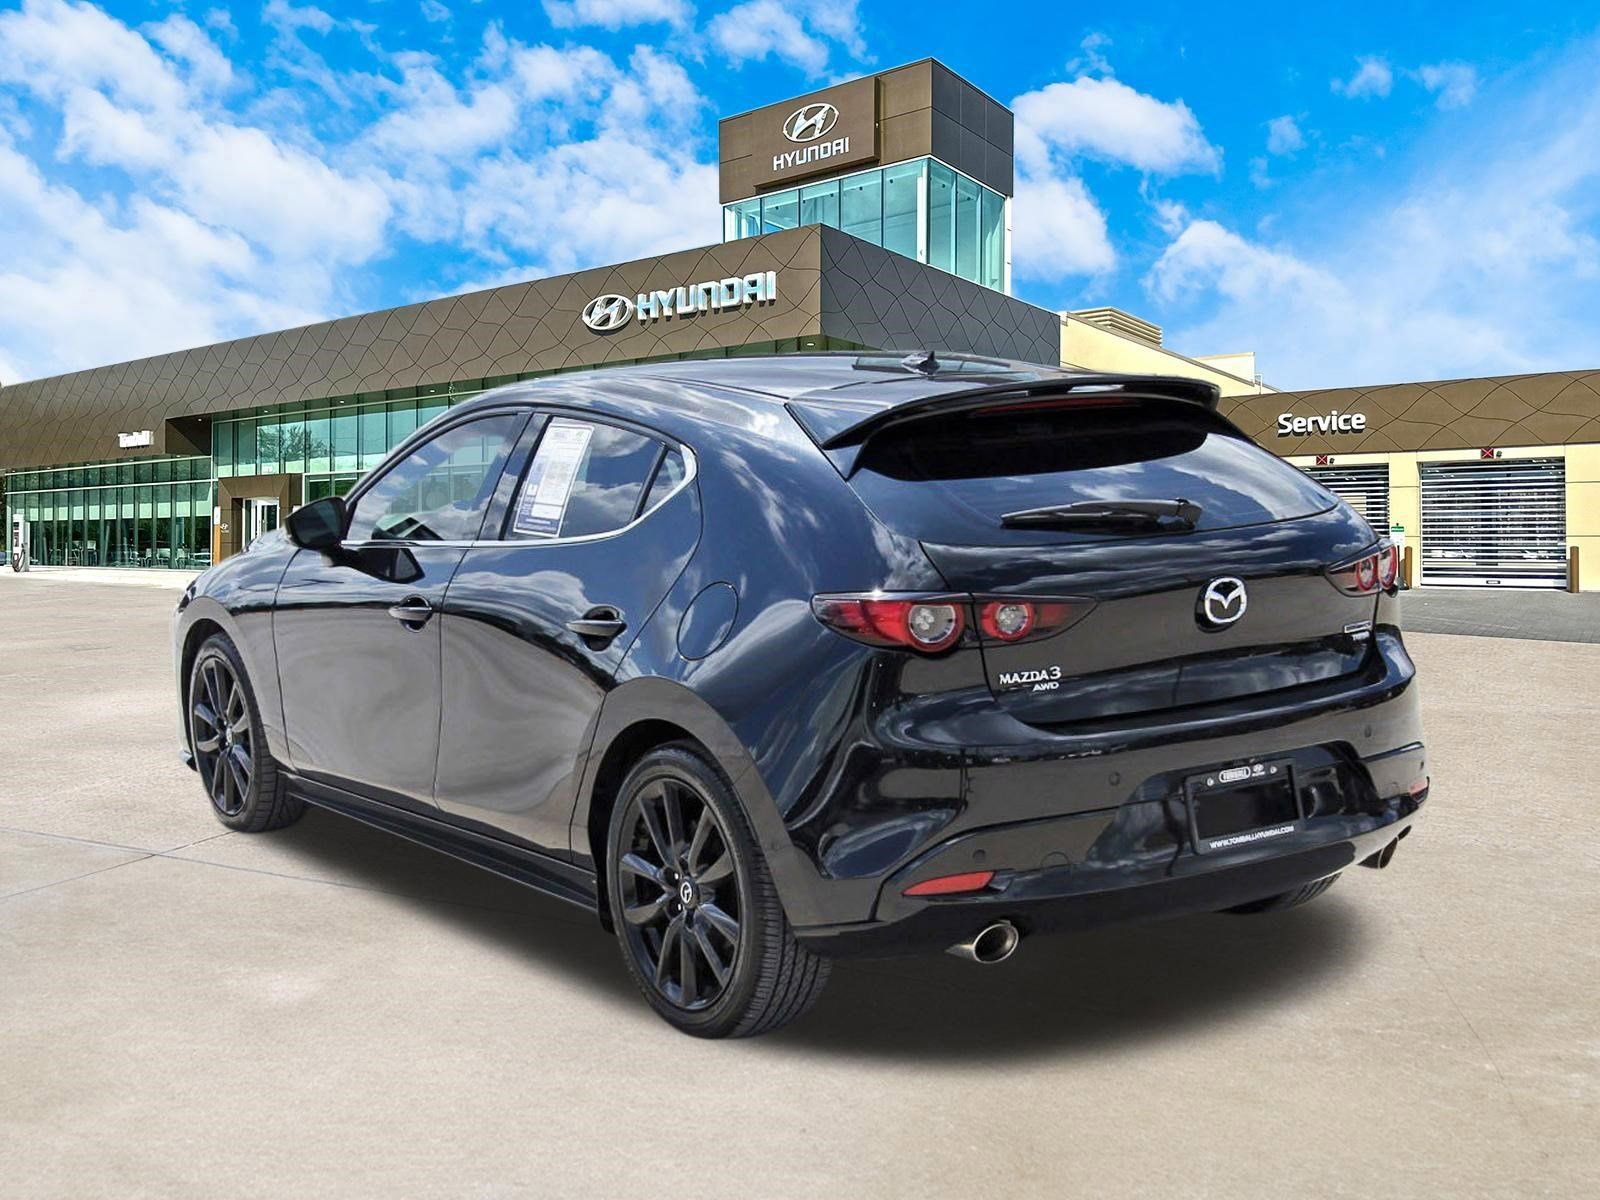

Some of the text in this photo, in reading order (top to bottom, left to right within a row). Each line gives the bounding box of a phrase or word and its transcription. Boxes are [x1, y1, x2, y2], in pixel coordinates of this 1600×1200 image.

[773, 137, 849, 171] HYUNDAI
[637, 270, 777, 321] HYUNDAI
[1277, 410, 1367, 435] Service
[1032, 682, 1060, 692] AWD
